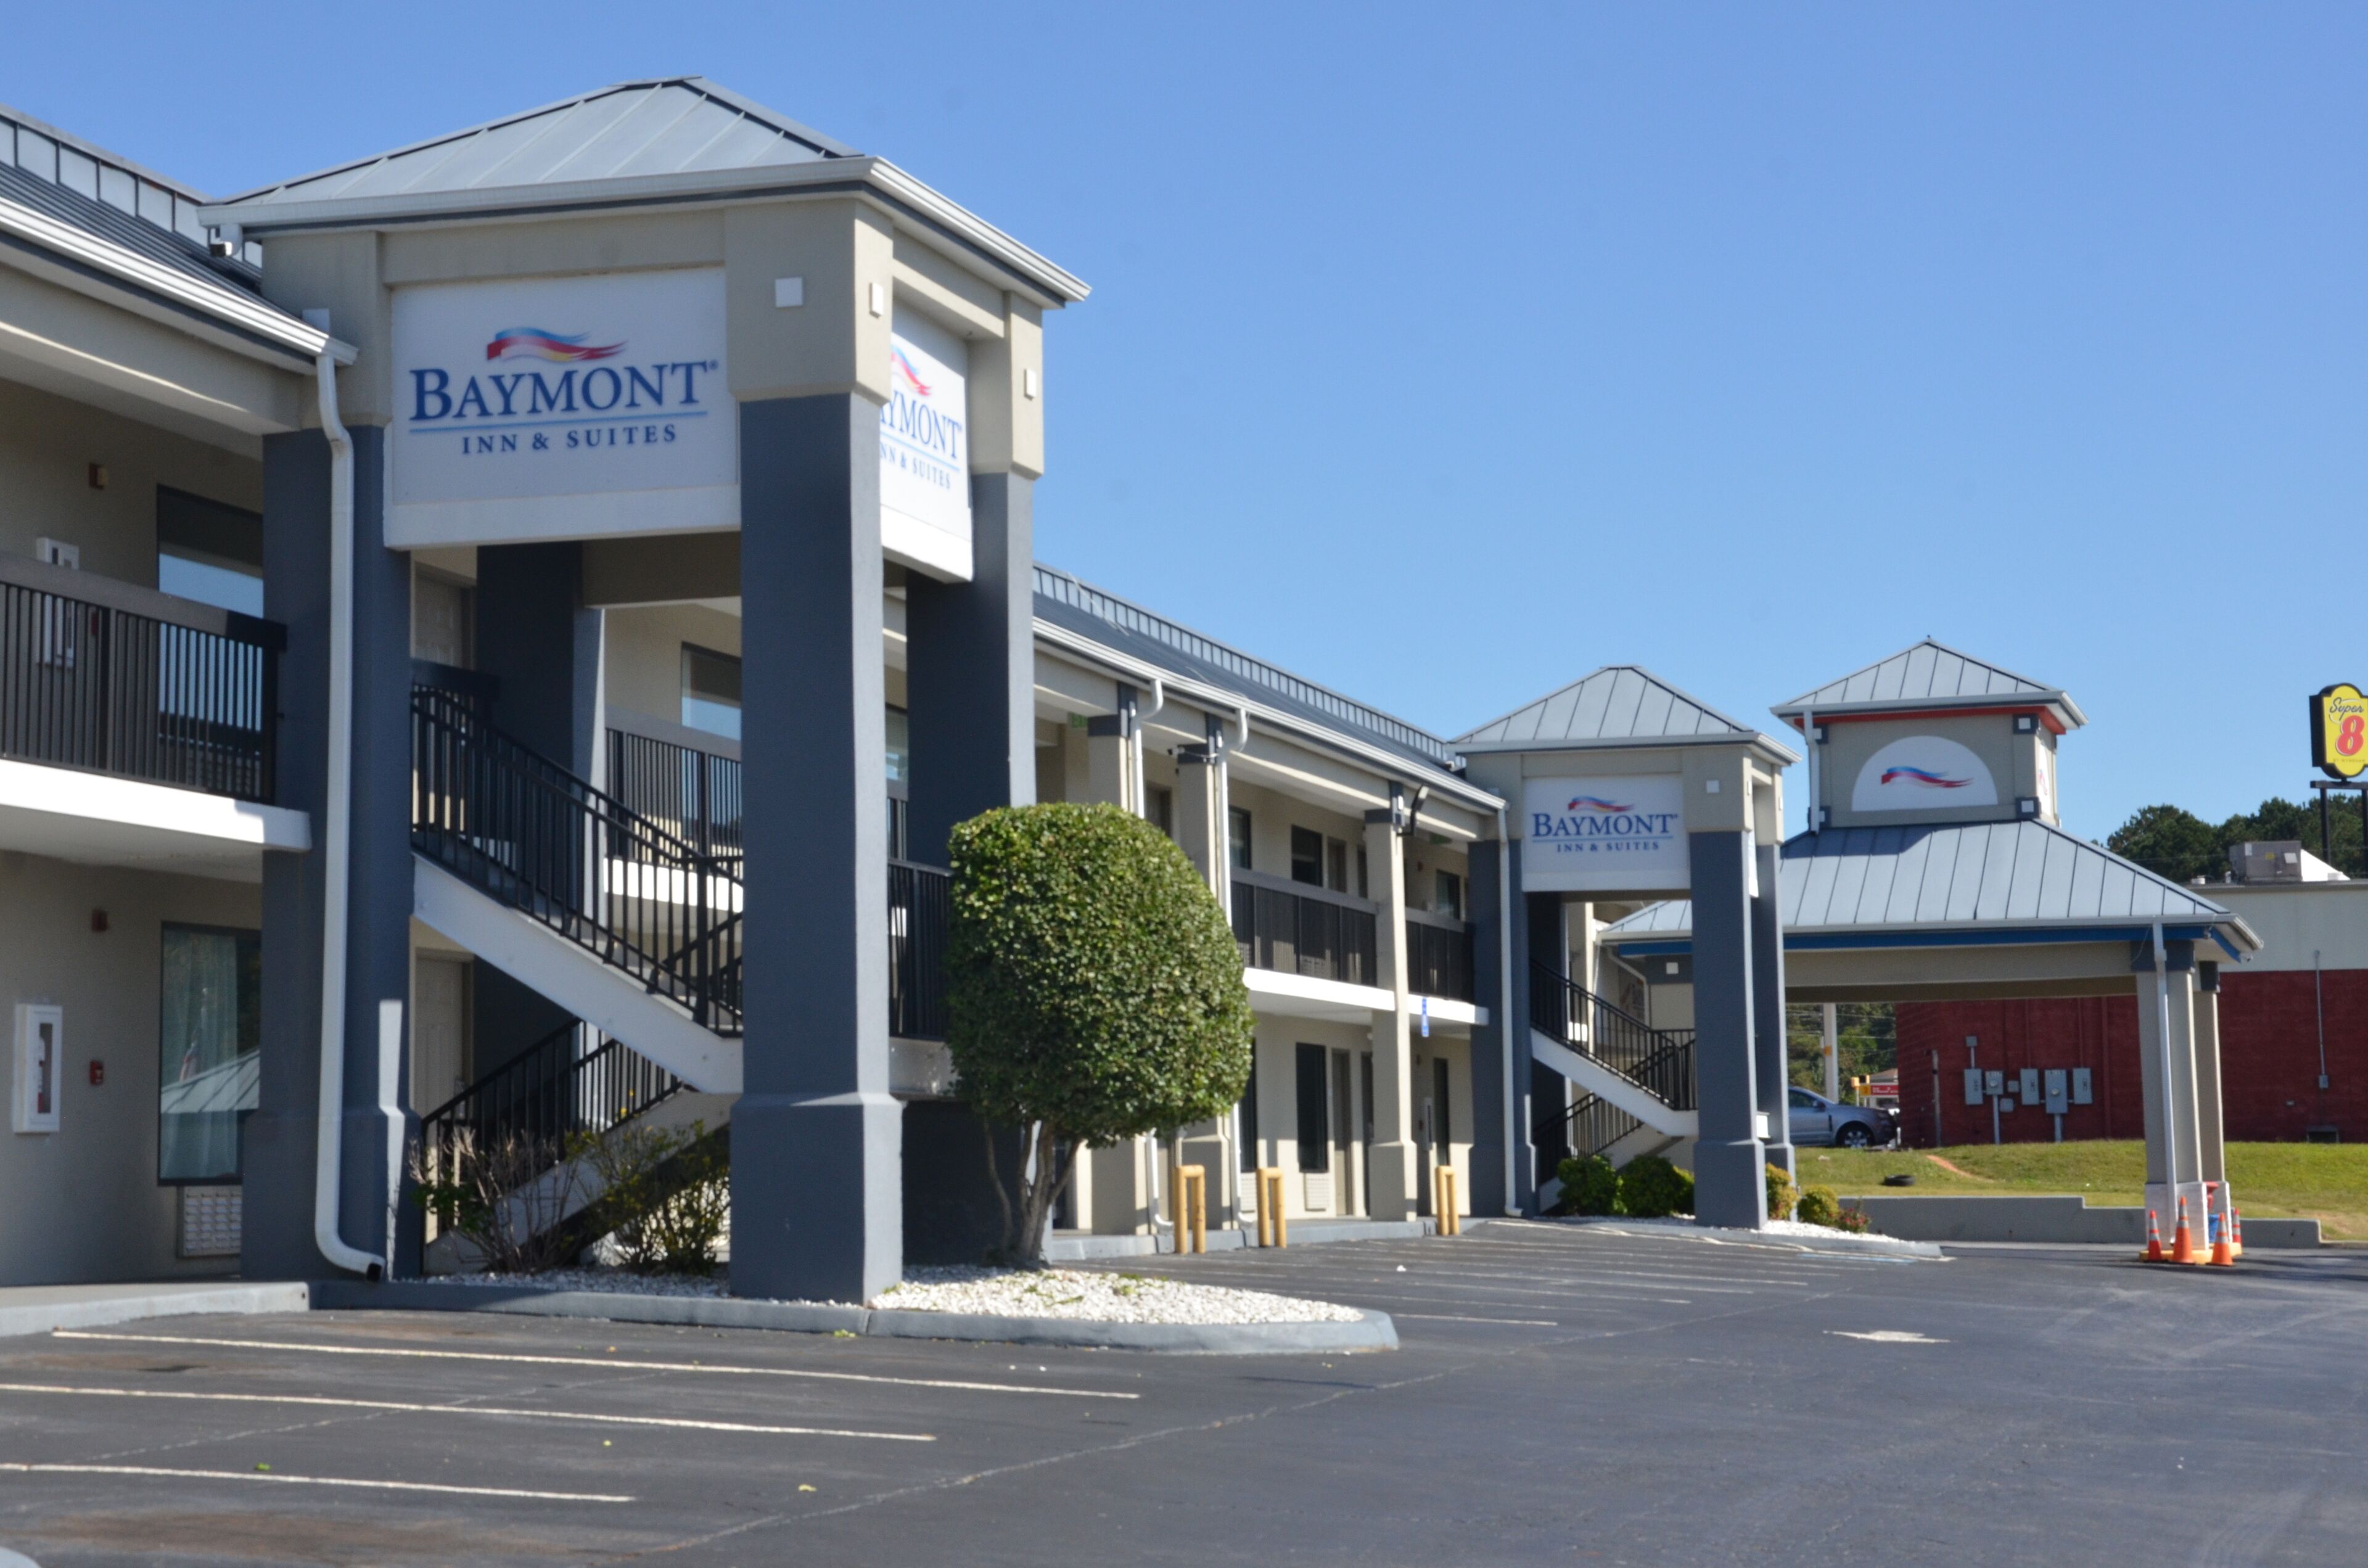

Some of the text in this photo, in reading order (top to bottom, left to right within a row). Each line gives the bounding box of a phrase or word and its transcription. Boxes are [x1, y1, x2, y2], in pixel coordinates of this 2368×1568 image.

[462, 424, 676, 454] INN & SUITES
[881, 390, 959, 459] YMONT
[881, 443, 896, 464] NN
[913, 457, 950, 489] SUITES
[2329, 697, 2364, 721] Super
[2335, 715, 2365, 756] 8
[1557, 842, 1659, 853] INN & SUITES
